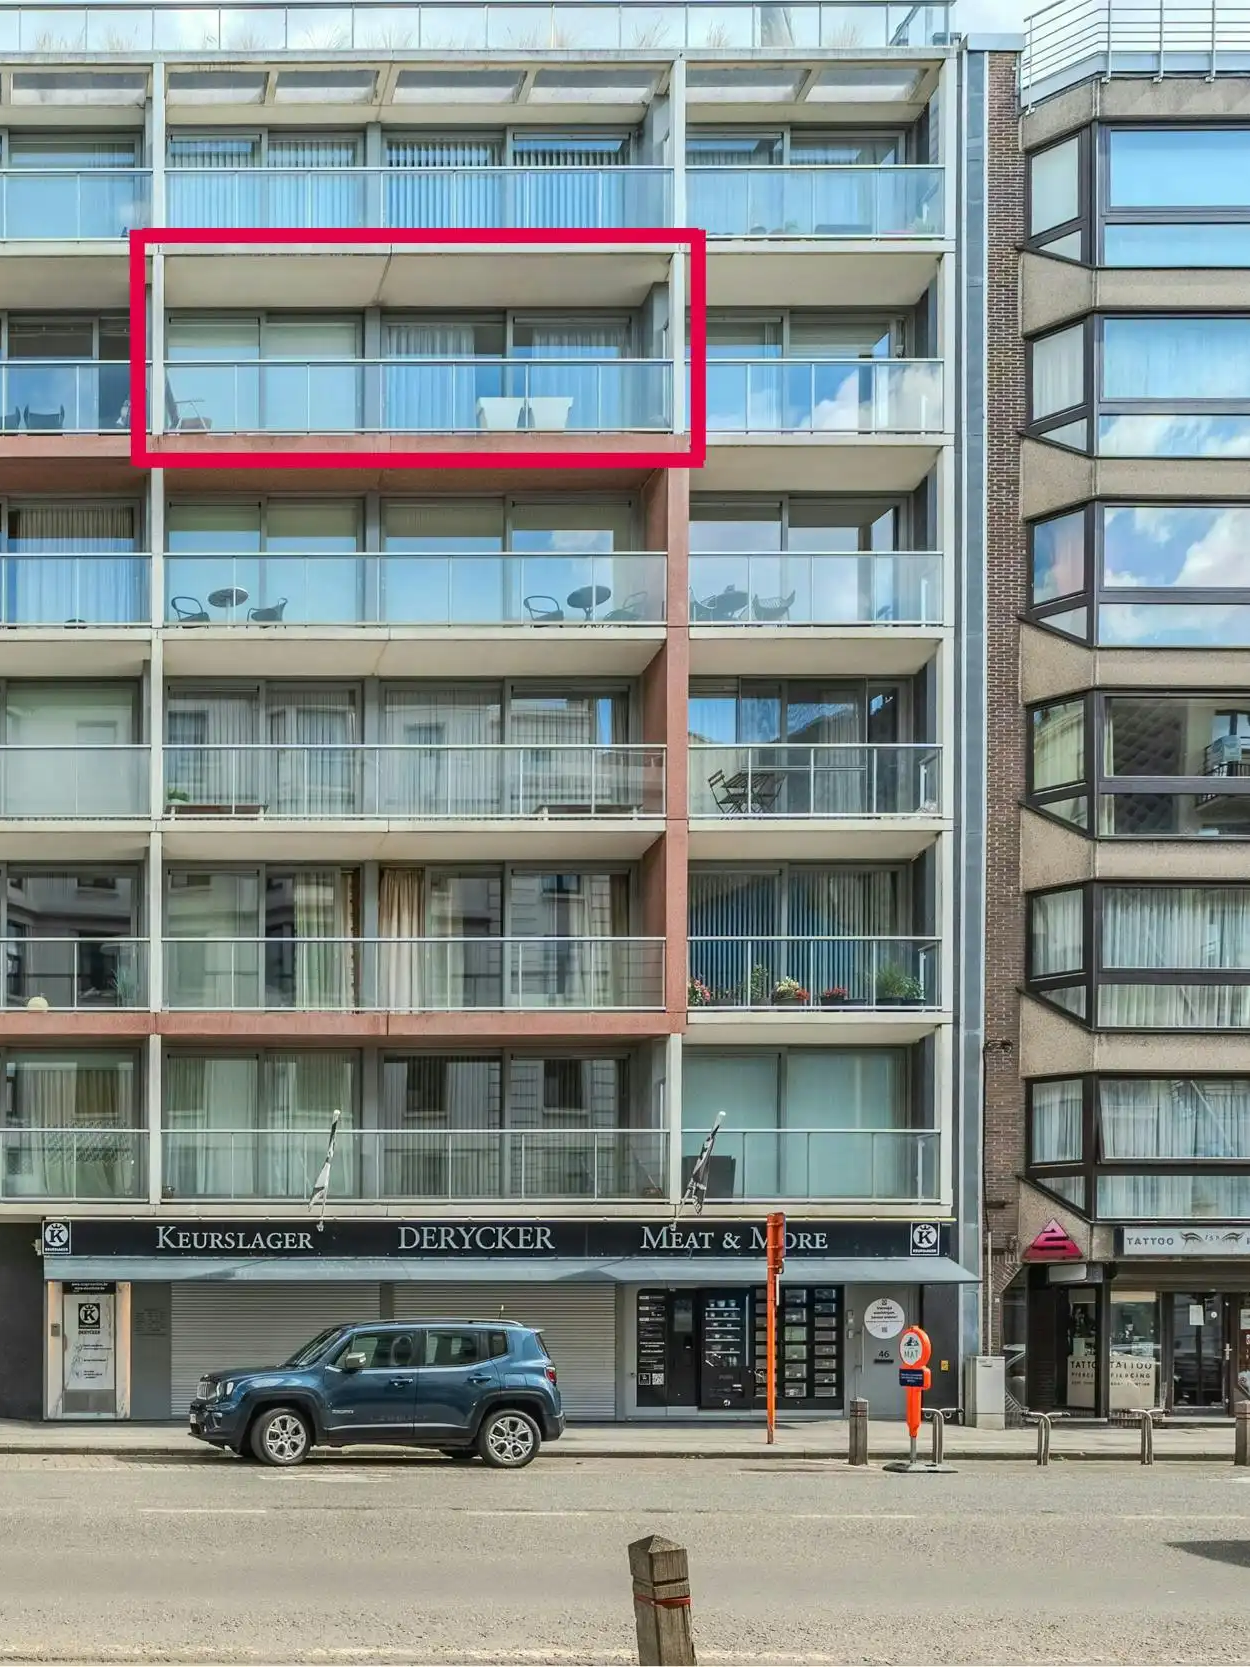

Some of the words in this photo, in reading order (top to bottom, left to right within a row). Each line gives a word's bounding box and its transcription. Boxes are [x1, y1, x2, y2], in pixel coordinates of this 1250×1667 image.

[49, 1229, 64, 1243] K
[156, 1226, 314, 1249] KEURSLAGER
[398, 1226, 556, 1250] DERYCKER
[640, 1226, 715, 1249] MEAT
[722, 1232, 741, 1249] &
[917, 1230, 933, 1244] K
[1126, 1237, 1174, 1246] TATTOO
[82, 1309, 96, 1321] K
[878, 1350, 890, 1358] 46
[904, 1350, 919, 1360] MAT
